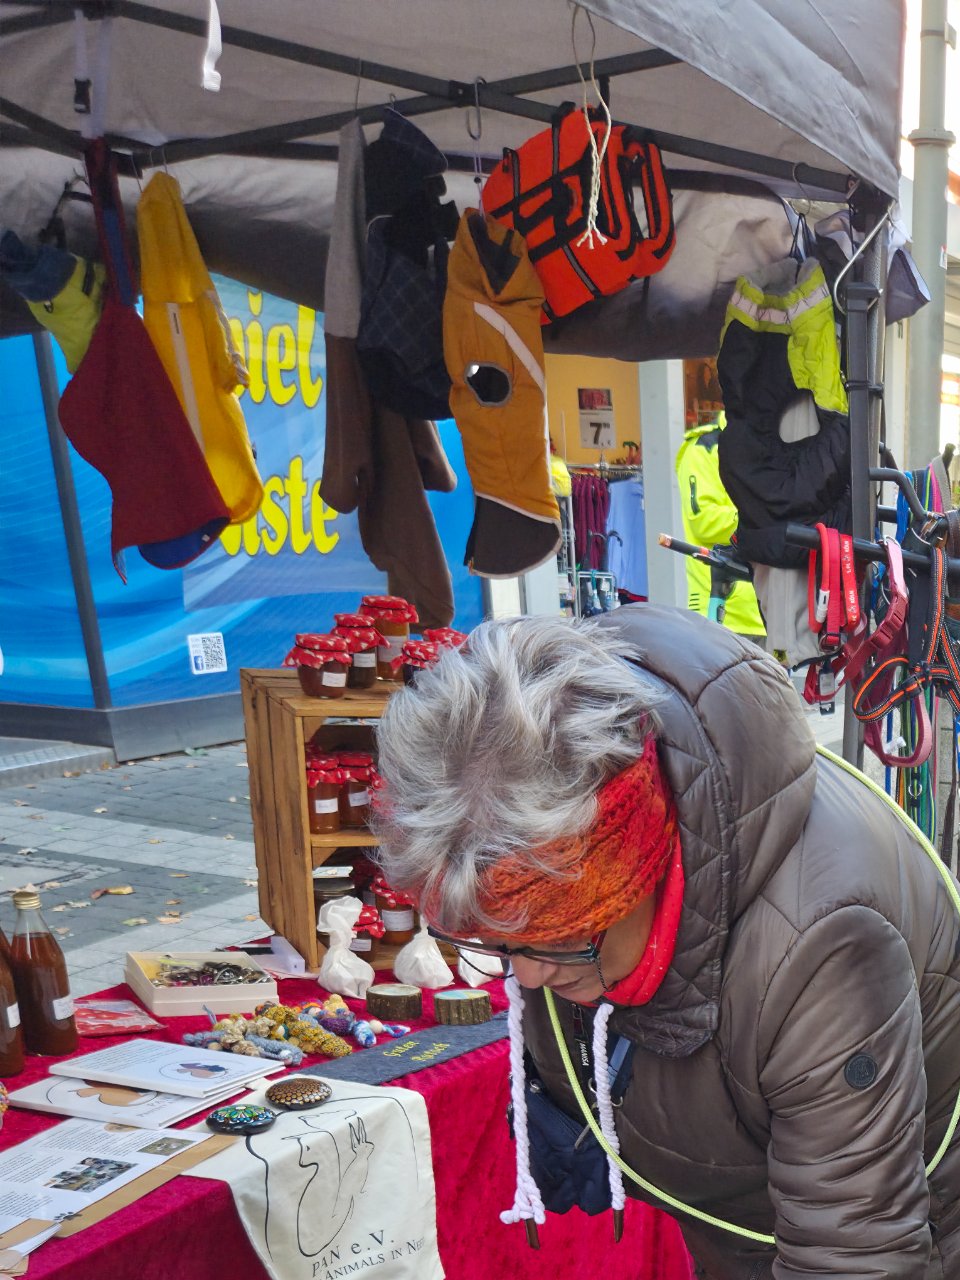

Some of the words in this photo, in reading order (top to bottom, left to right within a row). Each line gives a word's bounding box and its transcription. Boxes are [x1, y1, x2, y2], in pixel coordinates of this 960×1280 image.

[312, 1246, 341, 1277] PAN
[350, 1229, 395, 1255] e.V.
[391, 1247, 403, 1260] IN
